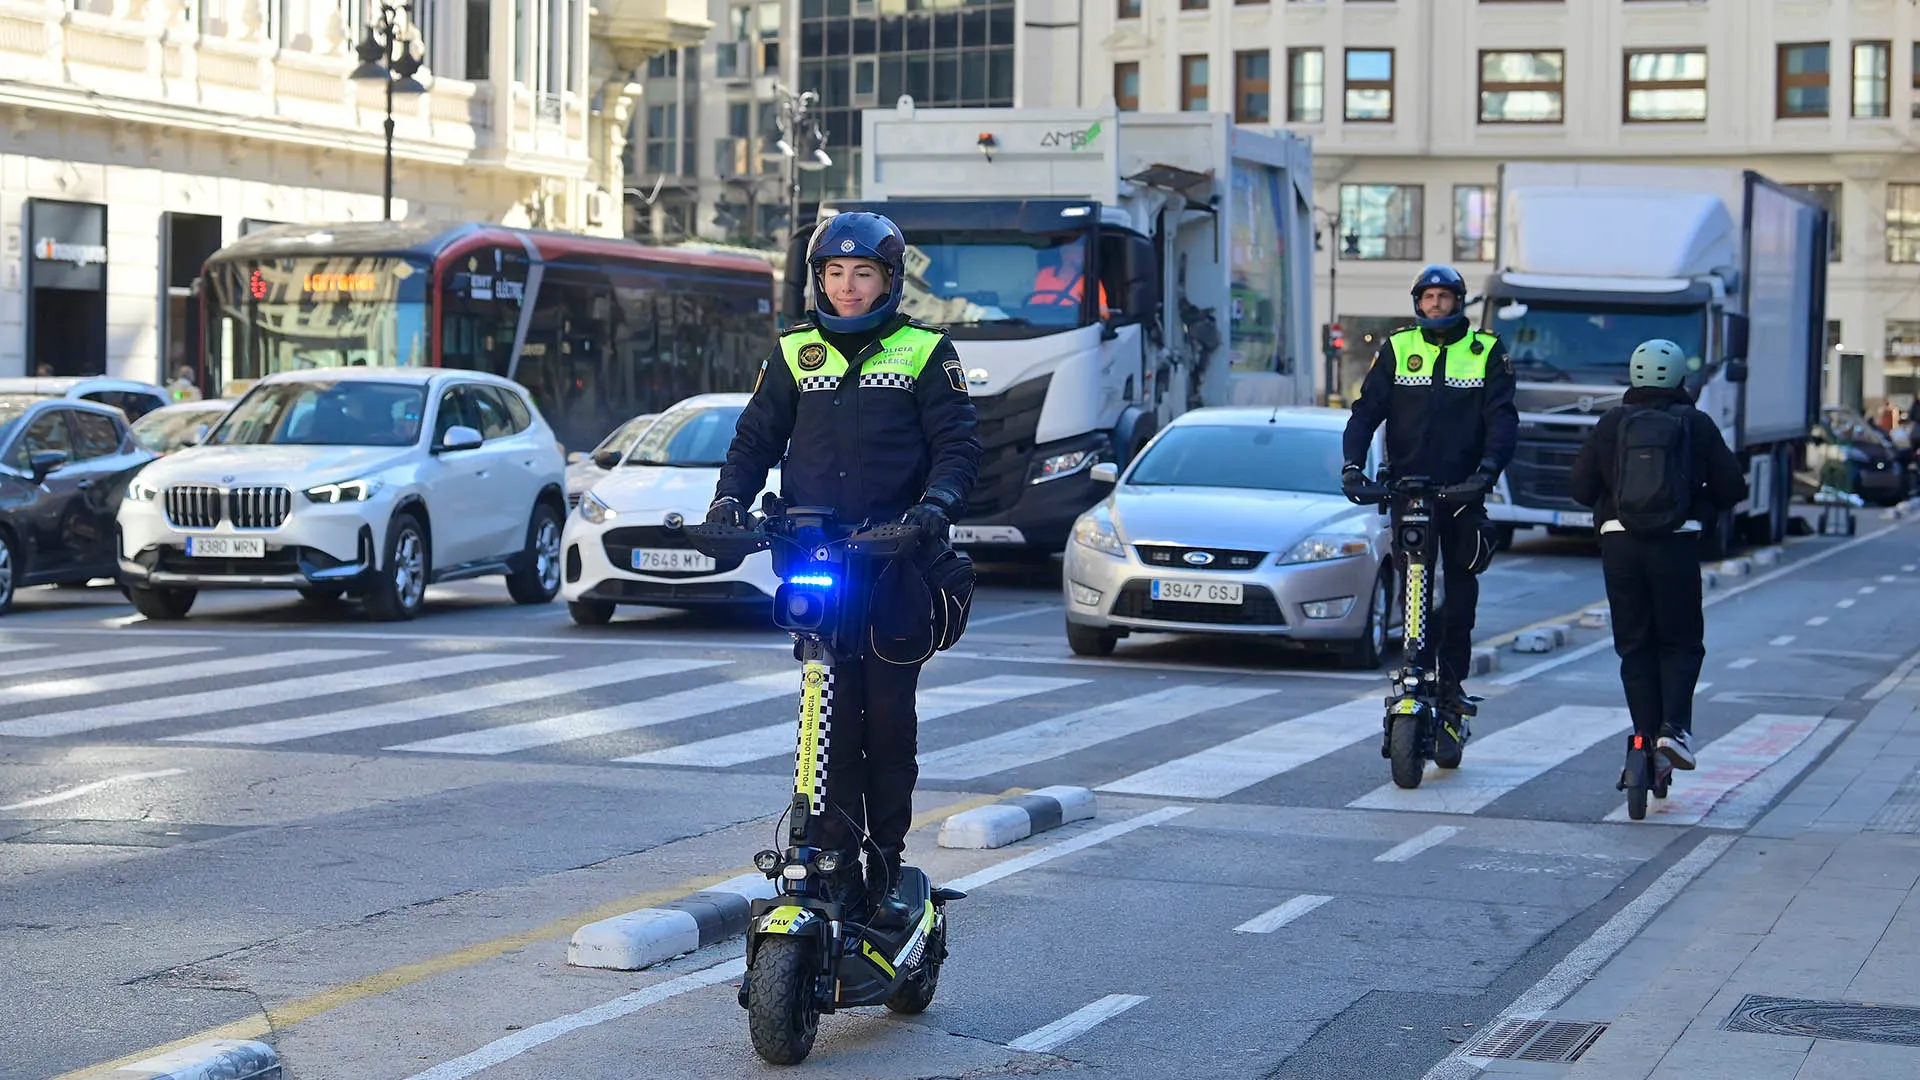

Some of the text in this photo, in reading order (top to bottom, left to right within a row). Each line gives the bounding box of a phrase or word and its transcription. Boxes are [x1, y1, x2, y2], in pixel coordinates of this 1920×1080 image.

[251, 270, 267, 298] 6
[197, 540, 228, 554] 3380
[642, 552, 678, 567] 7648
[1162, 583, 1240, 601] 3947 GSJ
